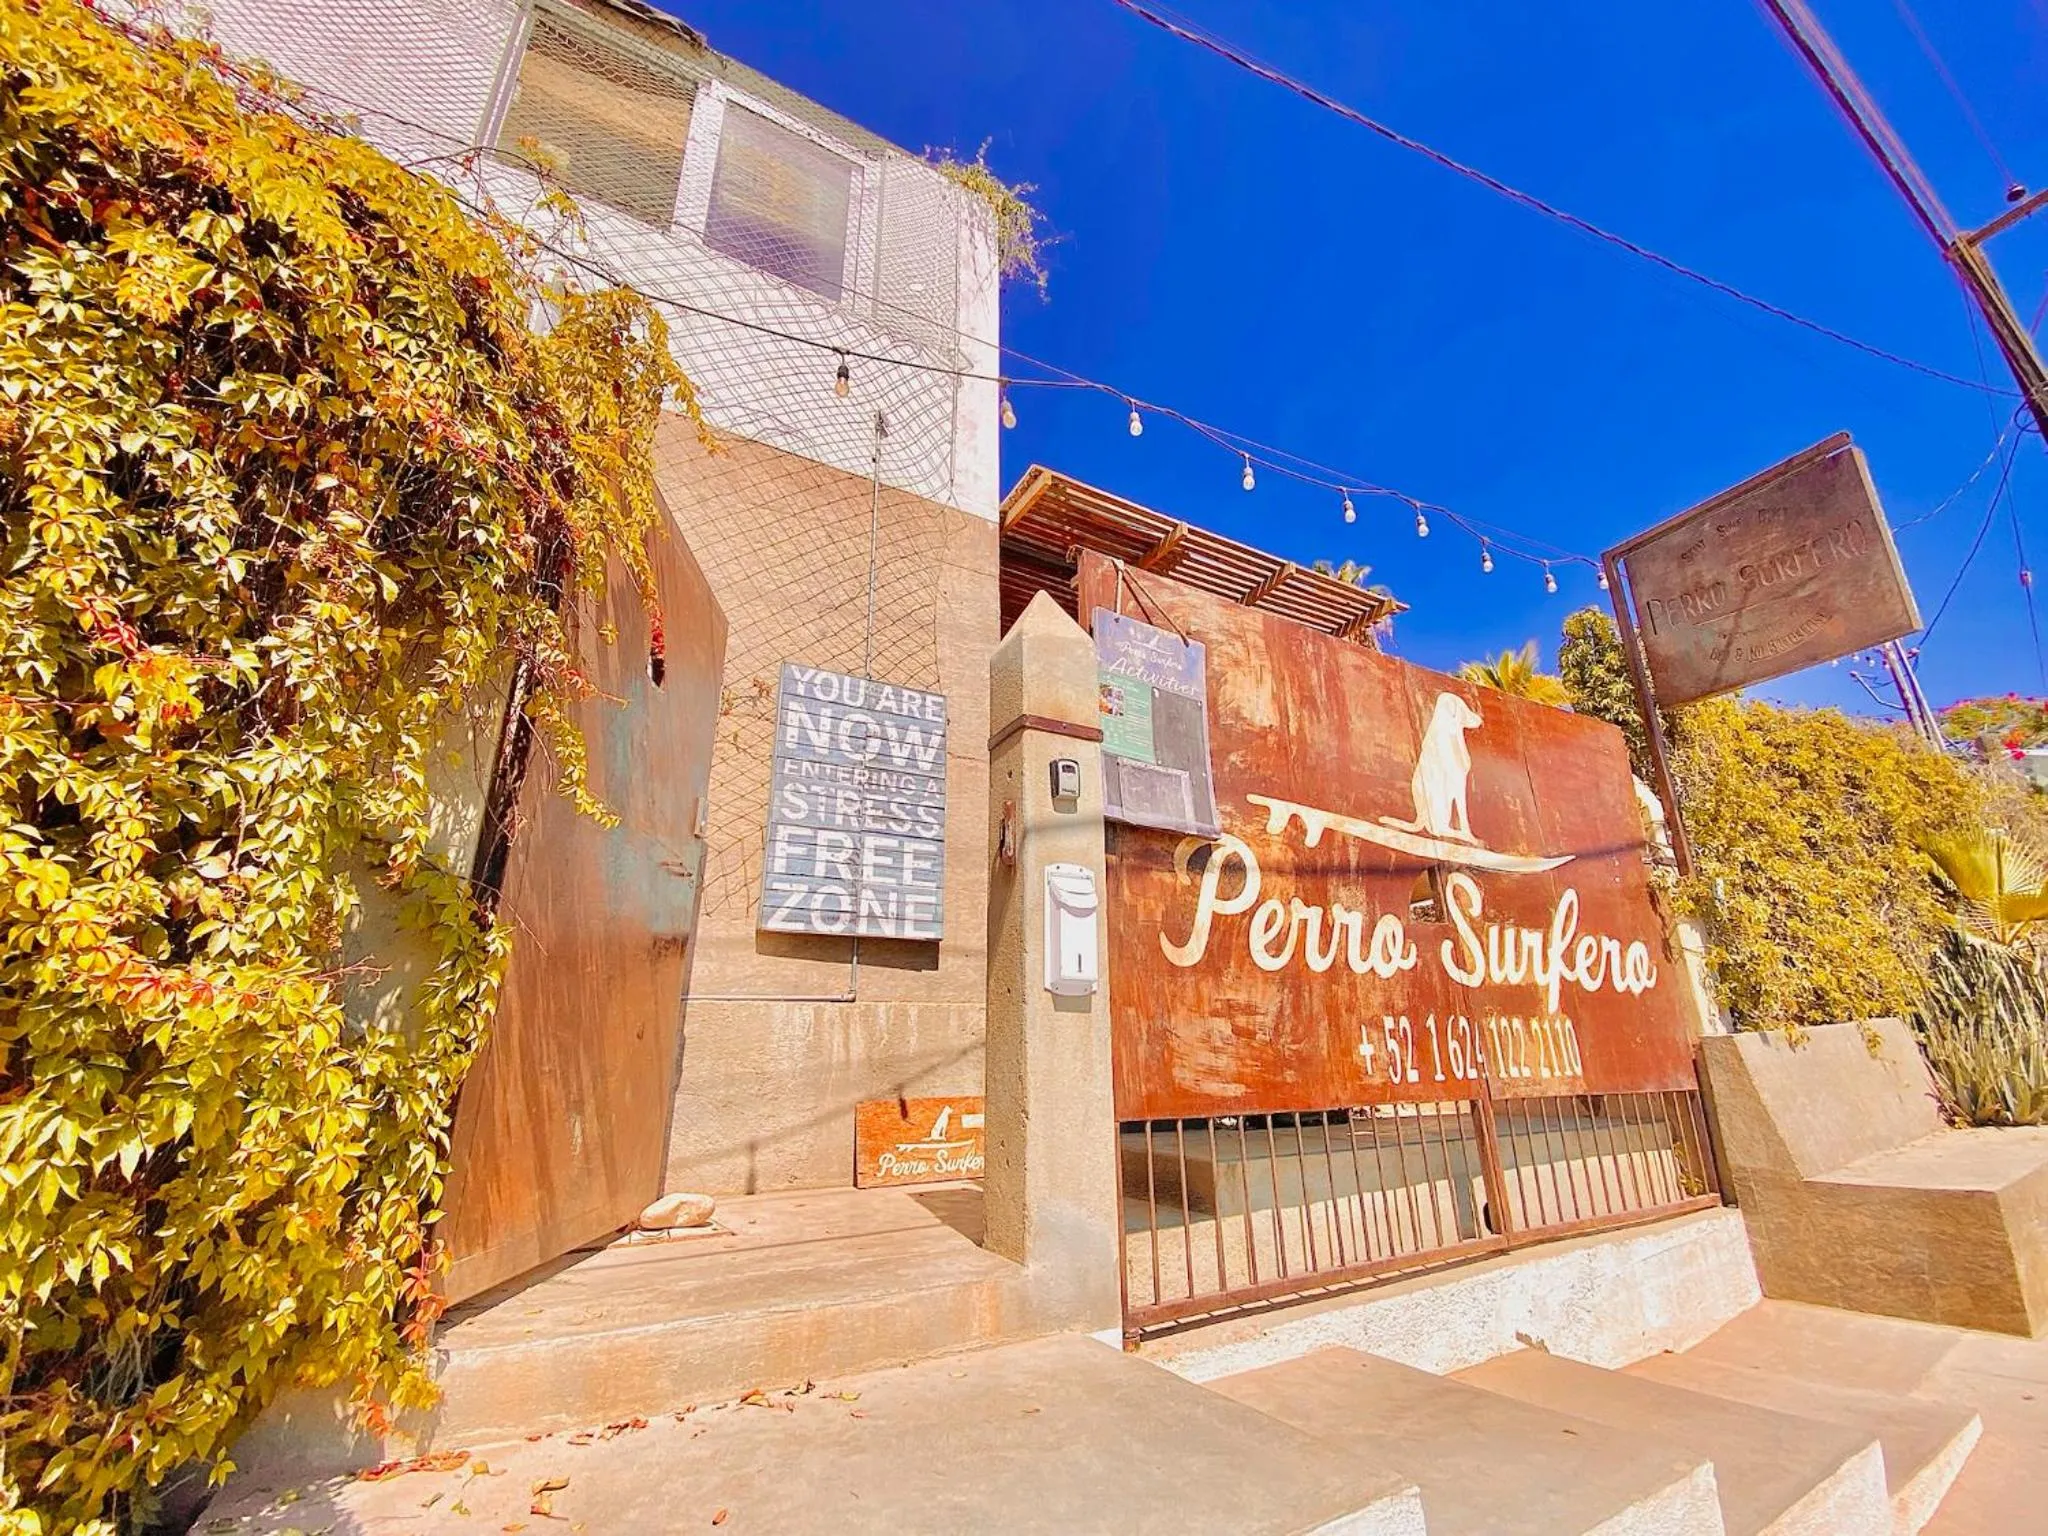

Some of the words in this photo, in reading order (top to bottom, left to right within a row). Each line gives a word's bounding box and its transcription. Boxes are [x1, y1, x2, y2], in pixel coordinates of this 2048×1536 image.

[790, 665, 866, 708] YOU
[874, 685, 945, 723] ARE
[785, 701, 944, 771] NOW
[784, 758, 917, 795] ENTERING
[926, 778, 941, 798] A
[779, 782, 943, 838] STRESS
[773, 824, 938, 887] FREE
[766, 881, 937, 939] ZONE
[1159, 835, 1417, 980] Perro
[1441, 871, 1657, 1015] Surfero
[875, 1152, 930, 1177] Perro
